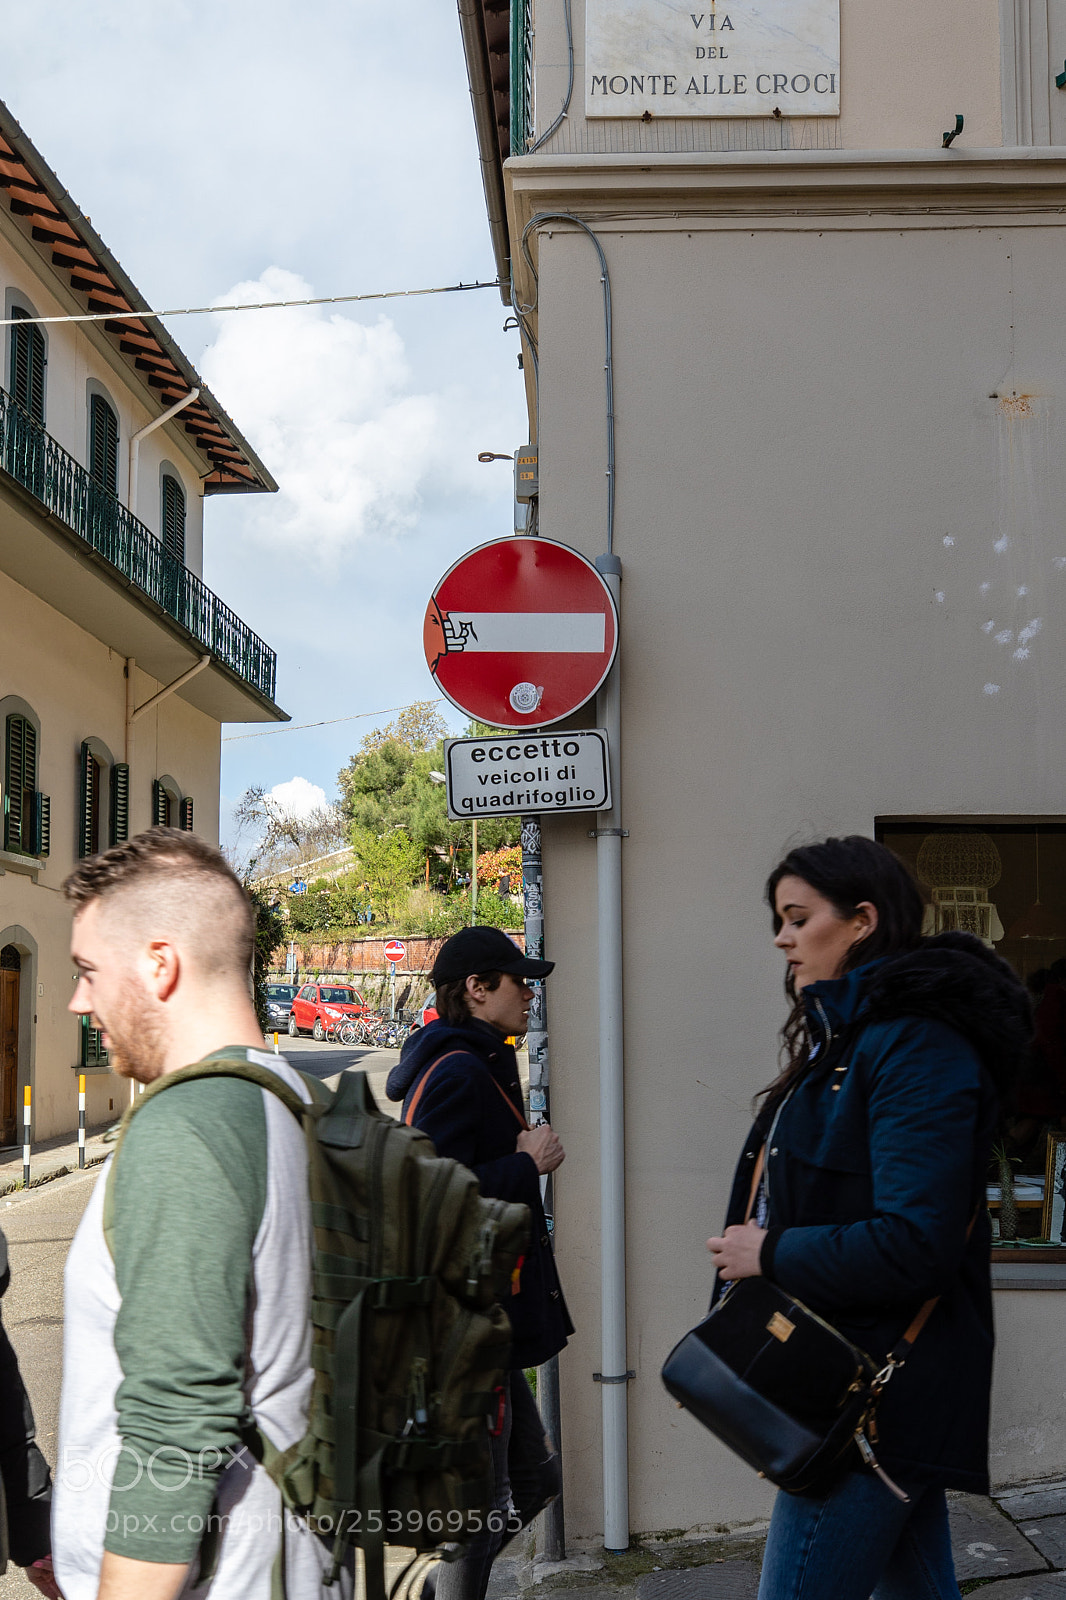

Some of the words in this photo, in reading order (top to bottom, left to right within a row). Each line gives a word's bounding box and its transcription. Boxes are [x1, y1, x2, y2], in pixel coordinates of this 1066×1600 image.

[690, 14, 735, 31] VIA
[695, 46, 729, 59] DEL
[590, 75, 677, 95] MONTE
[685, 74, 748, 95] ALLE
[755, 73, 836, 94] CROCI
[471, 739, 580, 763] eccetto
[478, 766, 550, 786] veicoli
[556, 765, 576, 781] di
[461, 787, 596, 811] quadrifoglio
